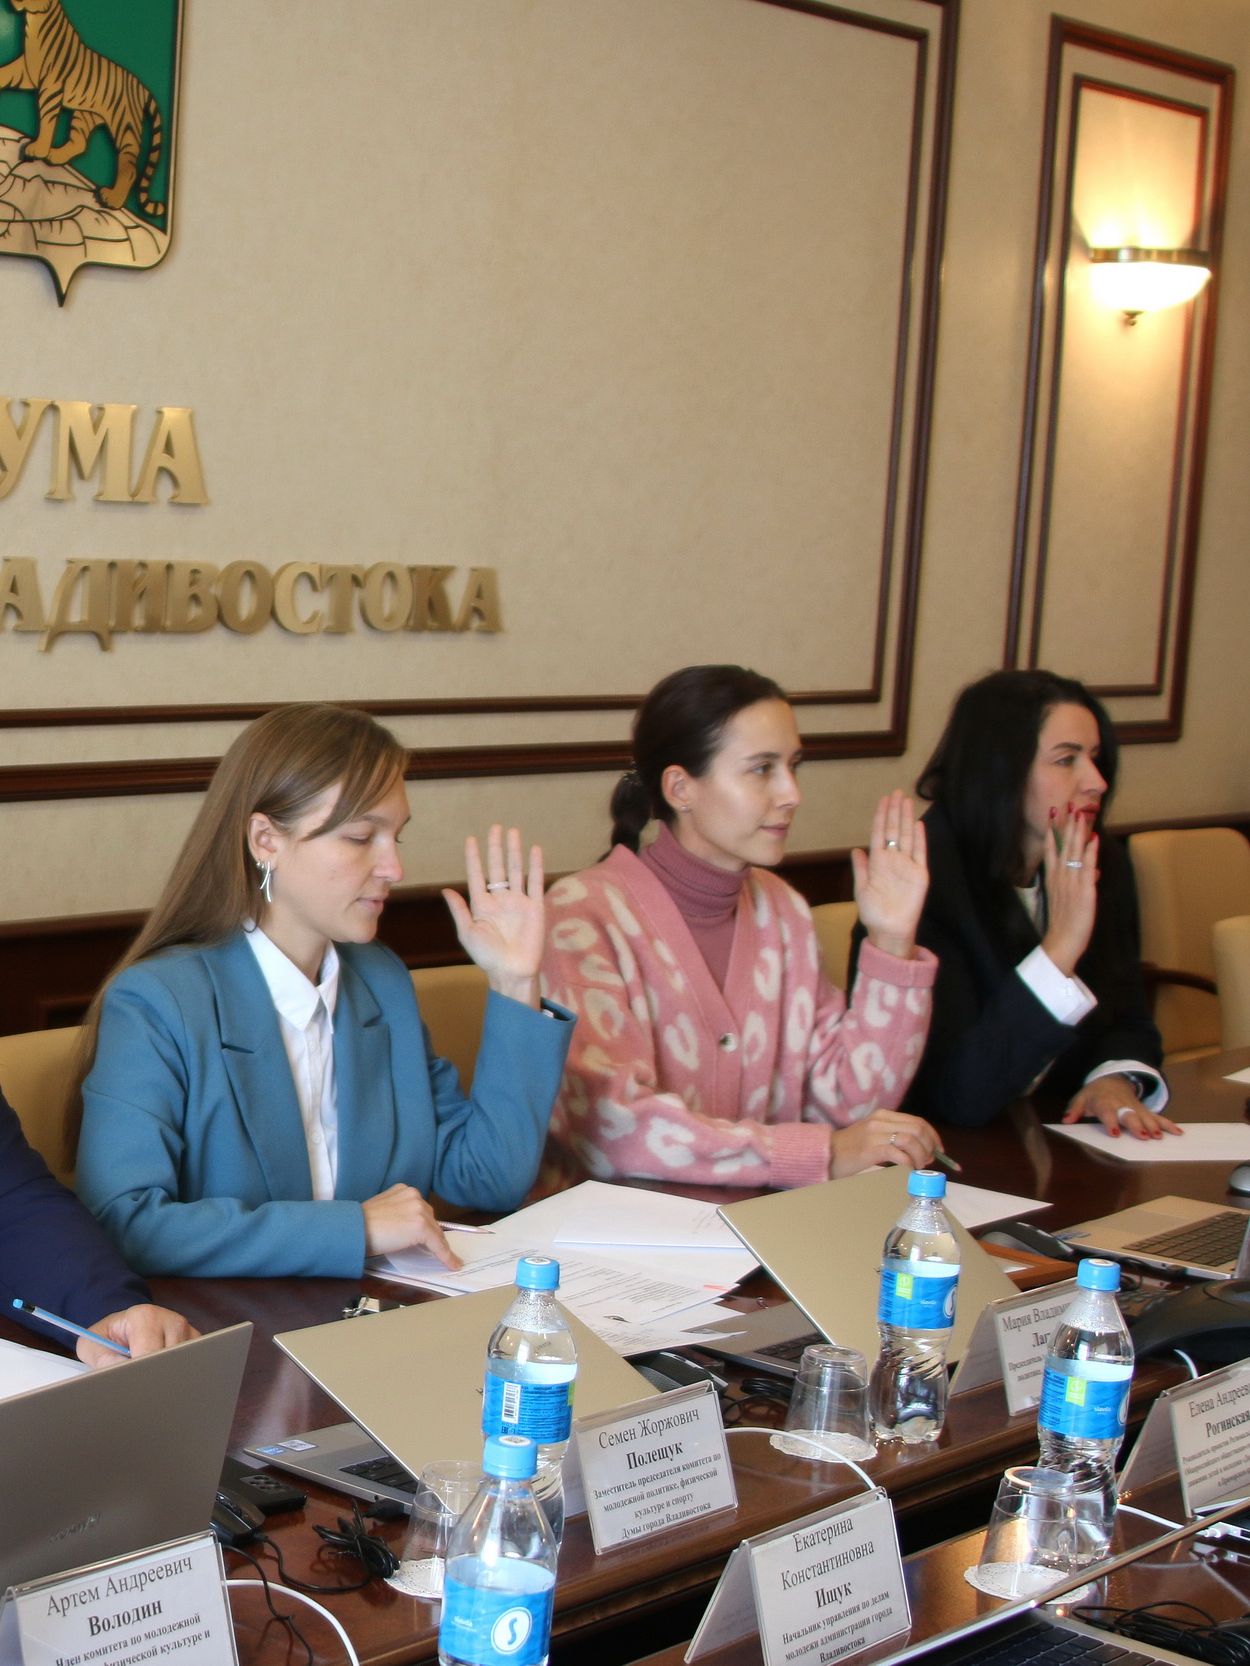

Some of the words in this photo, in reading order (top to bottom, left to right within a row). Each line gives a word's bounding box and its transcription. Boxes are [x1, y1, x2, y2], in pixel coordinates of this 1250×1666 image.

[1002, 1315, 1032, 1332] Мария
[1189, 1399, 1215, 1418] Елена
[1216, 1383, 1250, 1407] Андреев
[598, 1427, 637, 1449] Семен
[638, 1408, 700, 1437] Жоржович
[626, 1442, 684, 1470] Полещук
[593, 1480, 637, 1499] Заместитель
[637, 1465, 682, 1487] председателя
[682, 1456, 713, 1474] комитета
[713, 1452, 722, 1463] по
[603, 1491, 645, 1513] молодежной
[679, 1467, 719, 1489] физической
[621, 1525, 642, 1540] Думы
[642, 1517, 665, 1532] города
[665, 1501, 712, 1523] Владивостока
[634, 1501, 666, 1520] культуре
[666, 1499, 671, 1507] и
[672, 1492, 694, 1507] спорту
[792, 1518, 854, 1553] Екатерина
[780, 1540, 875, 1591] Константиновна
[47, 1586, 100, 1617] Артем
[105, 1556, 193, 1598] Андреевич
[815, 1582, 852, 1609] Ищук
[83, 1637, 129, 1662] комитета
[130, 1634, 142, 1646] по
[144, 1612, 201, 1640] молодежной
[87, 1599, 163, 1637] Володин
[782, 1621, 822, 1645] Начальник
[821, 1603, 861, 1630] управления
[861, 1600, 870, 1610] по
[871, 1591, 890, 1606] делам
[785, 1640, 820, 1661] молодежи
[820, 1616, 871, 1645] администрации
[871, 1607, 893, 1622] города
[160, 1632, 203, 1655] культуре
[204, 1629, 211, 1639] и
[819, 1637, 866, 1663] Владивостока
